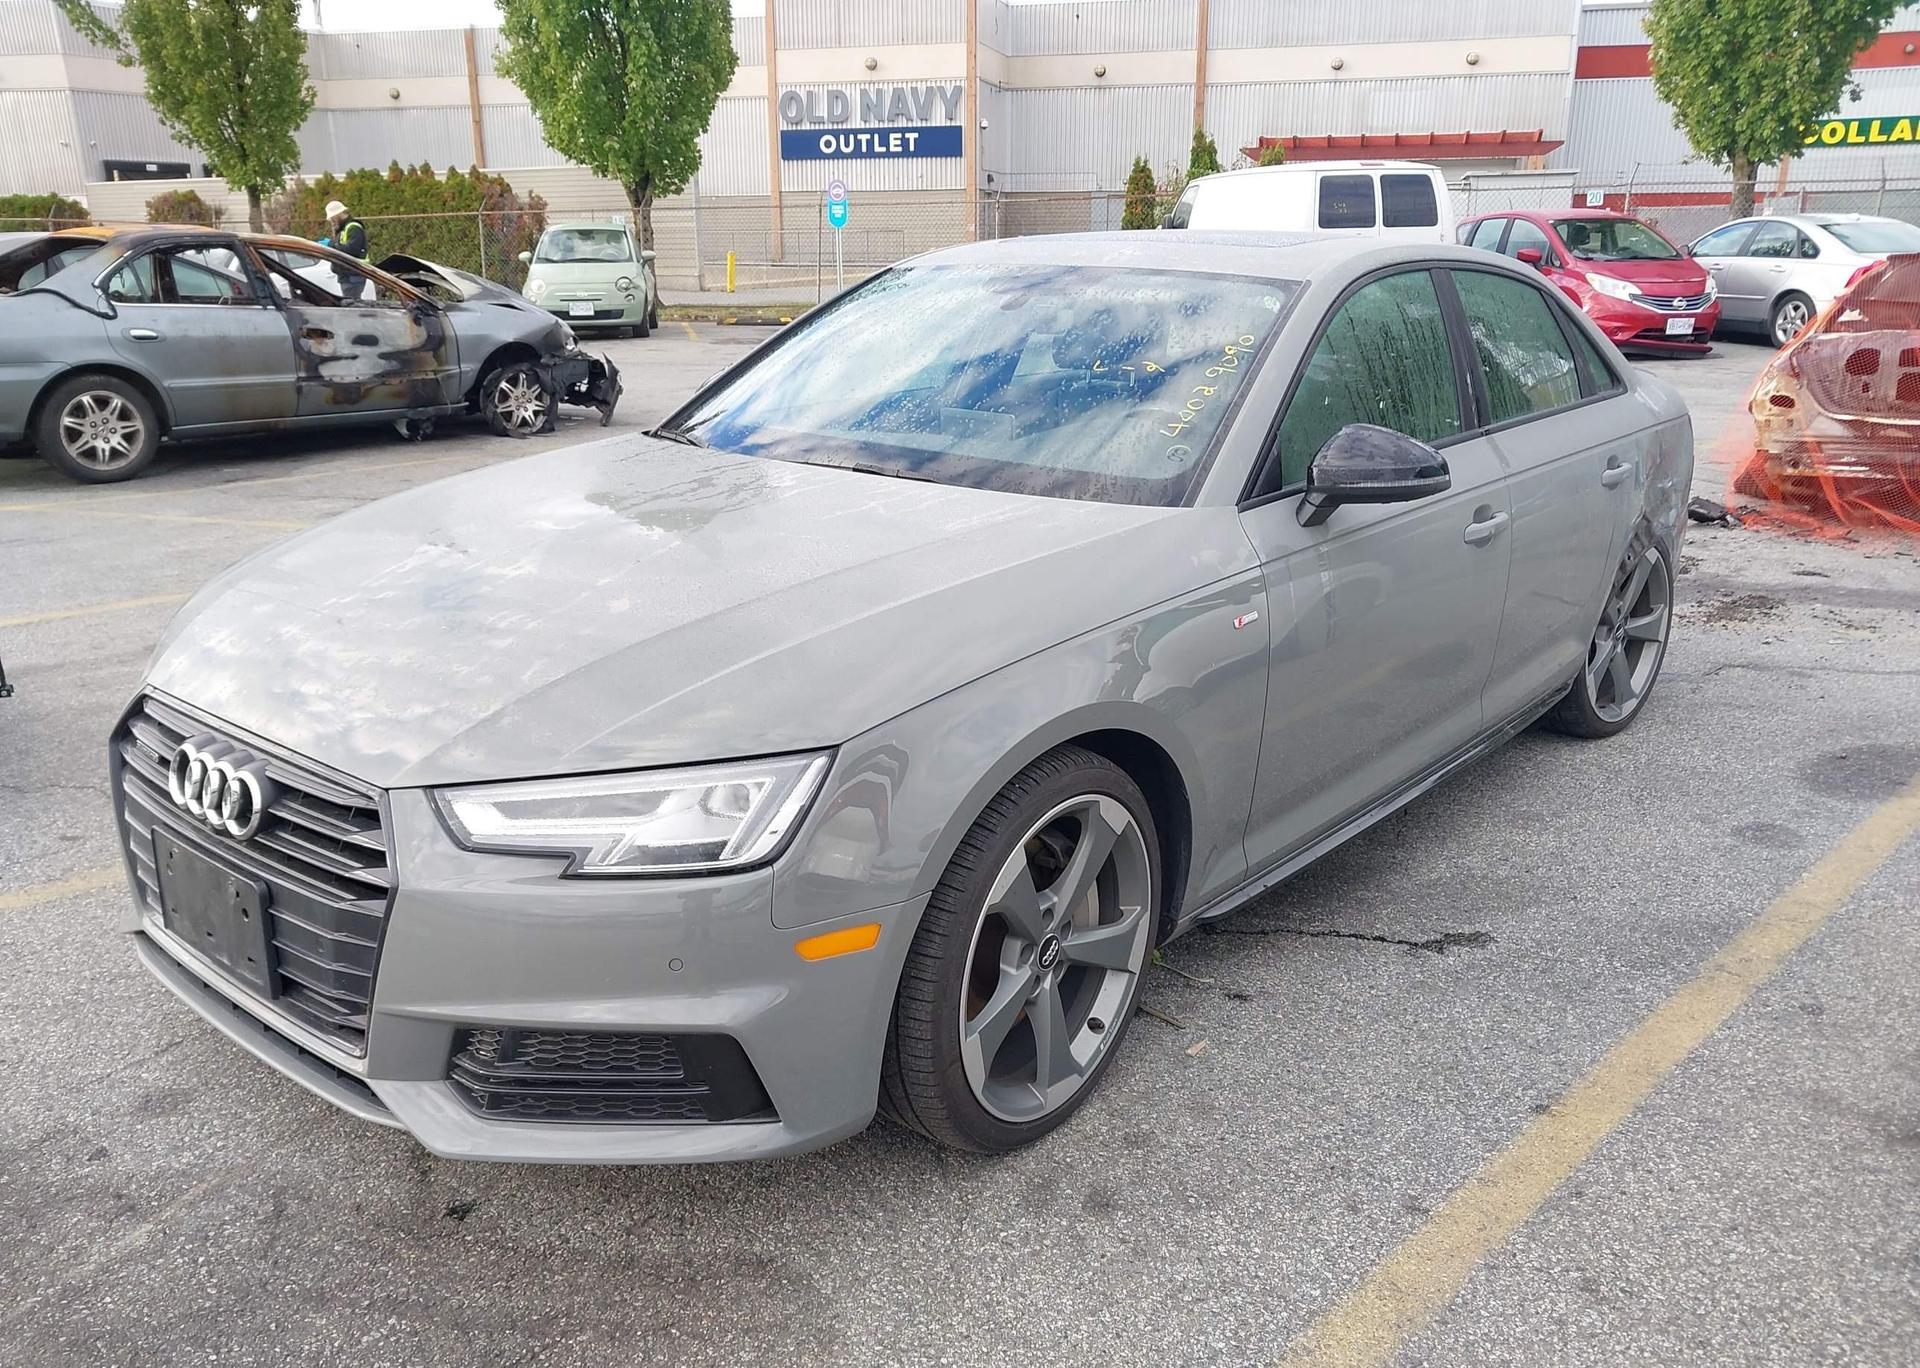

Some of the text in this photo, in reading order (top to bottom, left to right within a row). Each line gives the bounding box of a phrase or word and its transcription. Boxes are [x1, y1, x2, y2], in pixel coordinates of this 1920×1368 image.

[779, 85, 963, 124] OLD NAVY
[819, 132, 919, 154] OUTLET
[1798, 118, 1920, 145] OLLA
[1588, 191, 1602, 204] 20
